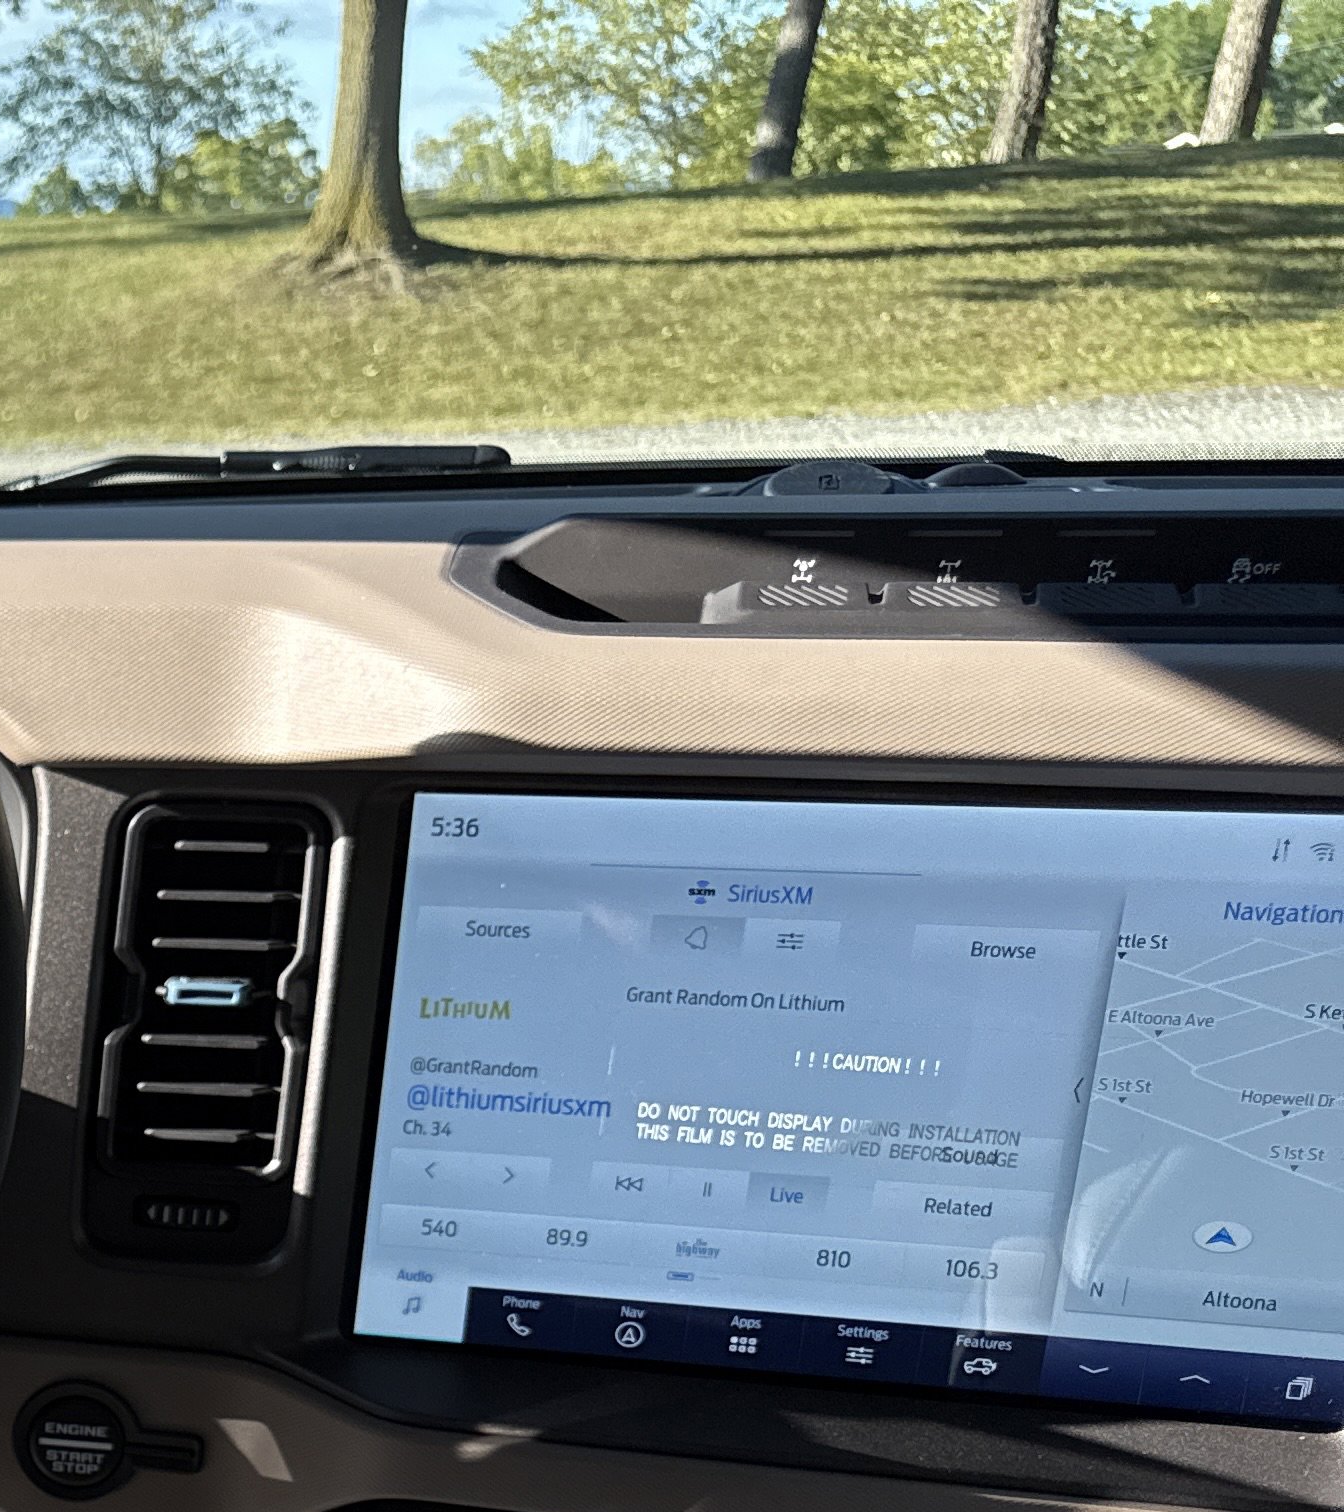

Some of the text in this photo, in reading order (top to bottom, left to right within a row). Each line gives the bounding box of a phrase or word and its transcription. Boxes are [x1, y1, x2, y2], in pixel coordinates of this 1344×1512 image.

[1252, 563, 1281, 575] OFF
[430, 816, 480, 839] 5:36
[727, 884, 814, 905] SiriusXM
[1224, 901, 1344, 926] Navigation
[464, 919, 531, 940] Sources
[970, 940, 1037, 961] Browse
[1150, 935, 1169, 950] St
[626, 986, 845, 1012] Grant Random On Lithium
[1108, 1009, 1215, 1028] E Altoona Ave
[1304, 1003, 1316, 1019] S
[409, 1056, 539, 1079] @GrantRandom
[1098, 1077, 1152, 1093] S 1st St
[407, 1083, 612, 1119] @lithiumsiriusxm
[1241, 1088, 1336, 1108] Hopewell Dr
[403, 1119, 452, 1138] Ch. 34
[637, 1102, 661, 1119] DO
[668, 1105, 701, 1122] NOT
[708, 1107, 760, 1127] TOUCH
[767, 1112, 833, 1132] DISPLAY
[908, 1122, 1021, 1147] INSTALLATION
[636, 1122, 669, 1141] THIS
[676, 1126, 713, 1144] FILM
[719, 1129, 735, 1147] IS
[744, 1131, 765, 1148] TO
[772, 1134, 796, 1151] BE
[802, 1136, 880, 1157] REMOVED
[1269, 1145, 1325, 1161] S 1st St
[769, 1186, 805, 1205] Live
[923, 1197, 993, 1218] Related
[421, 1218, 457, 1239] 540
[545, 1228, 588, 1248] 89.9
[816, 1249, 852, 1269] 810
[945, 1257, 999, 1280] 106.3
[396, 1269, 433, 1284] Audio
[1089, 1282, 1104, 1298] N
[502, 1295, 541, 1310] Phone
[1202, 1289, 1278, 1312] Altoona
[620, 1305, 646, 1319] Nav
[730, 1315, 762, 1330] Apps
[837, 1324, 890, 1342] Settings
[955, 1334, 1013, 1351] Features
[44, 1421, 109, 1438] ENGINE
[46, 1449, 105, 1465] START
[52, 1461, 99, 1475] STOP
